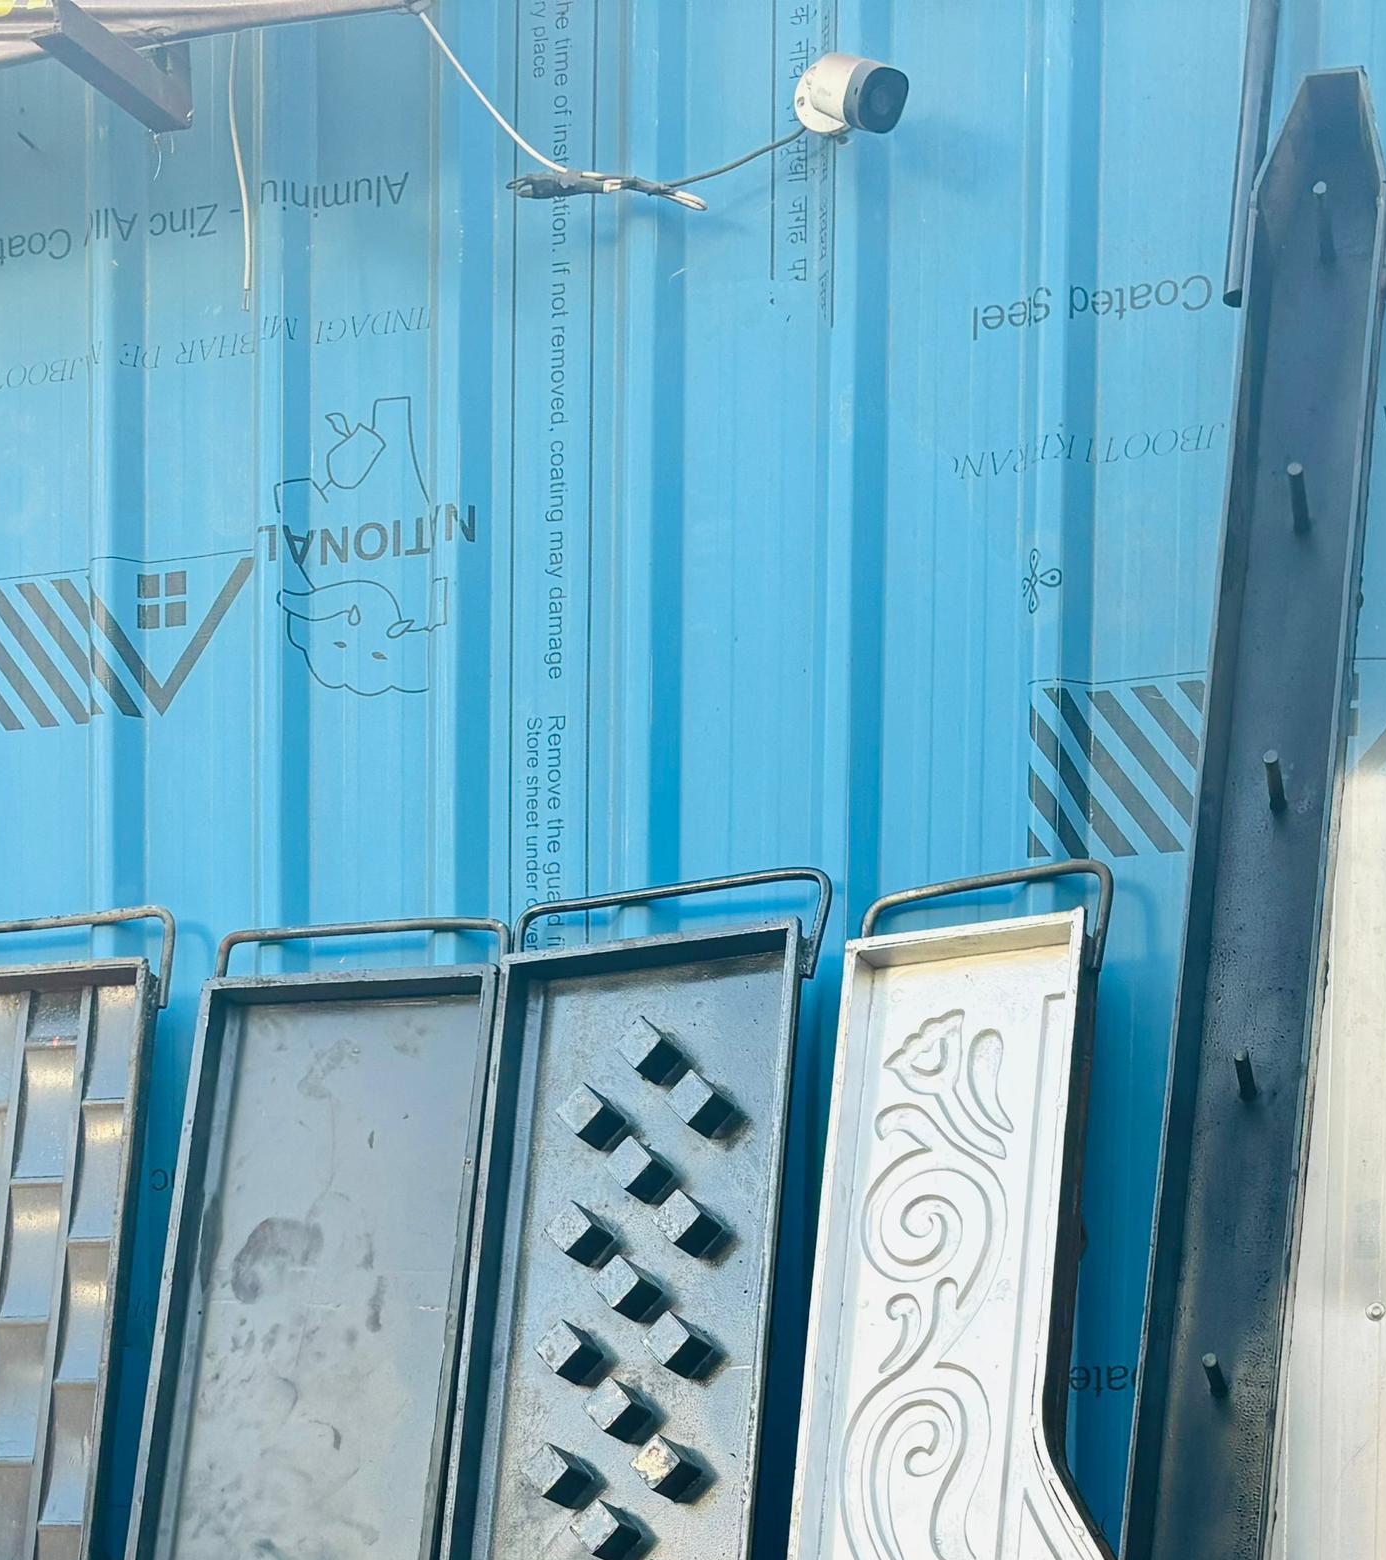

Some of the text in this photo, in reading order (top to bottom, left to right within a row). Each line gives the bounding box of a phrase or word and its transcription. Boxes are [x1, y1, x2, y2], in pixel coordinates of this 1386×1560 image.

[553, 0, 574, 29] he
[529, 26, 550, 79] place
[553, 37, 573, 86] time
[552, 95, 573, 117] of
[260, 171, 410, 218] Aluminiu
[149, 204, 218, 239] Zinc
[550, 262, 571, 278] If
[549, 282, 570, 319] not
[1069, 274, 1214, 320] Coated
[119, 343, 162, 369] DE
[546, 325, 570, 432] removed,
[543, 440, 568, 523] coating
[543, 531, 564, 578] may
[542, 586, 567, 680] damage
[525, 716, 544, 768] Store
[546, 715, 568, 810] Remove
[524, 775, 543, 828] sheet
[546, 819, 567, 853] the
[524, 836, 543, 891] under
[542, 861, 564, 927] guad
